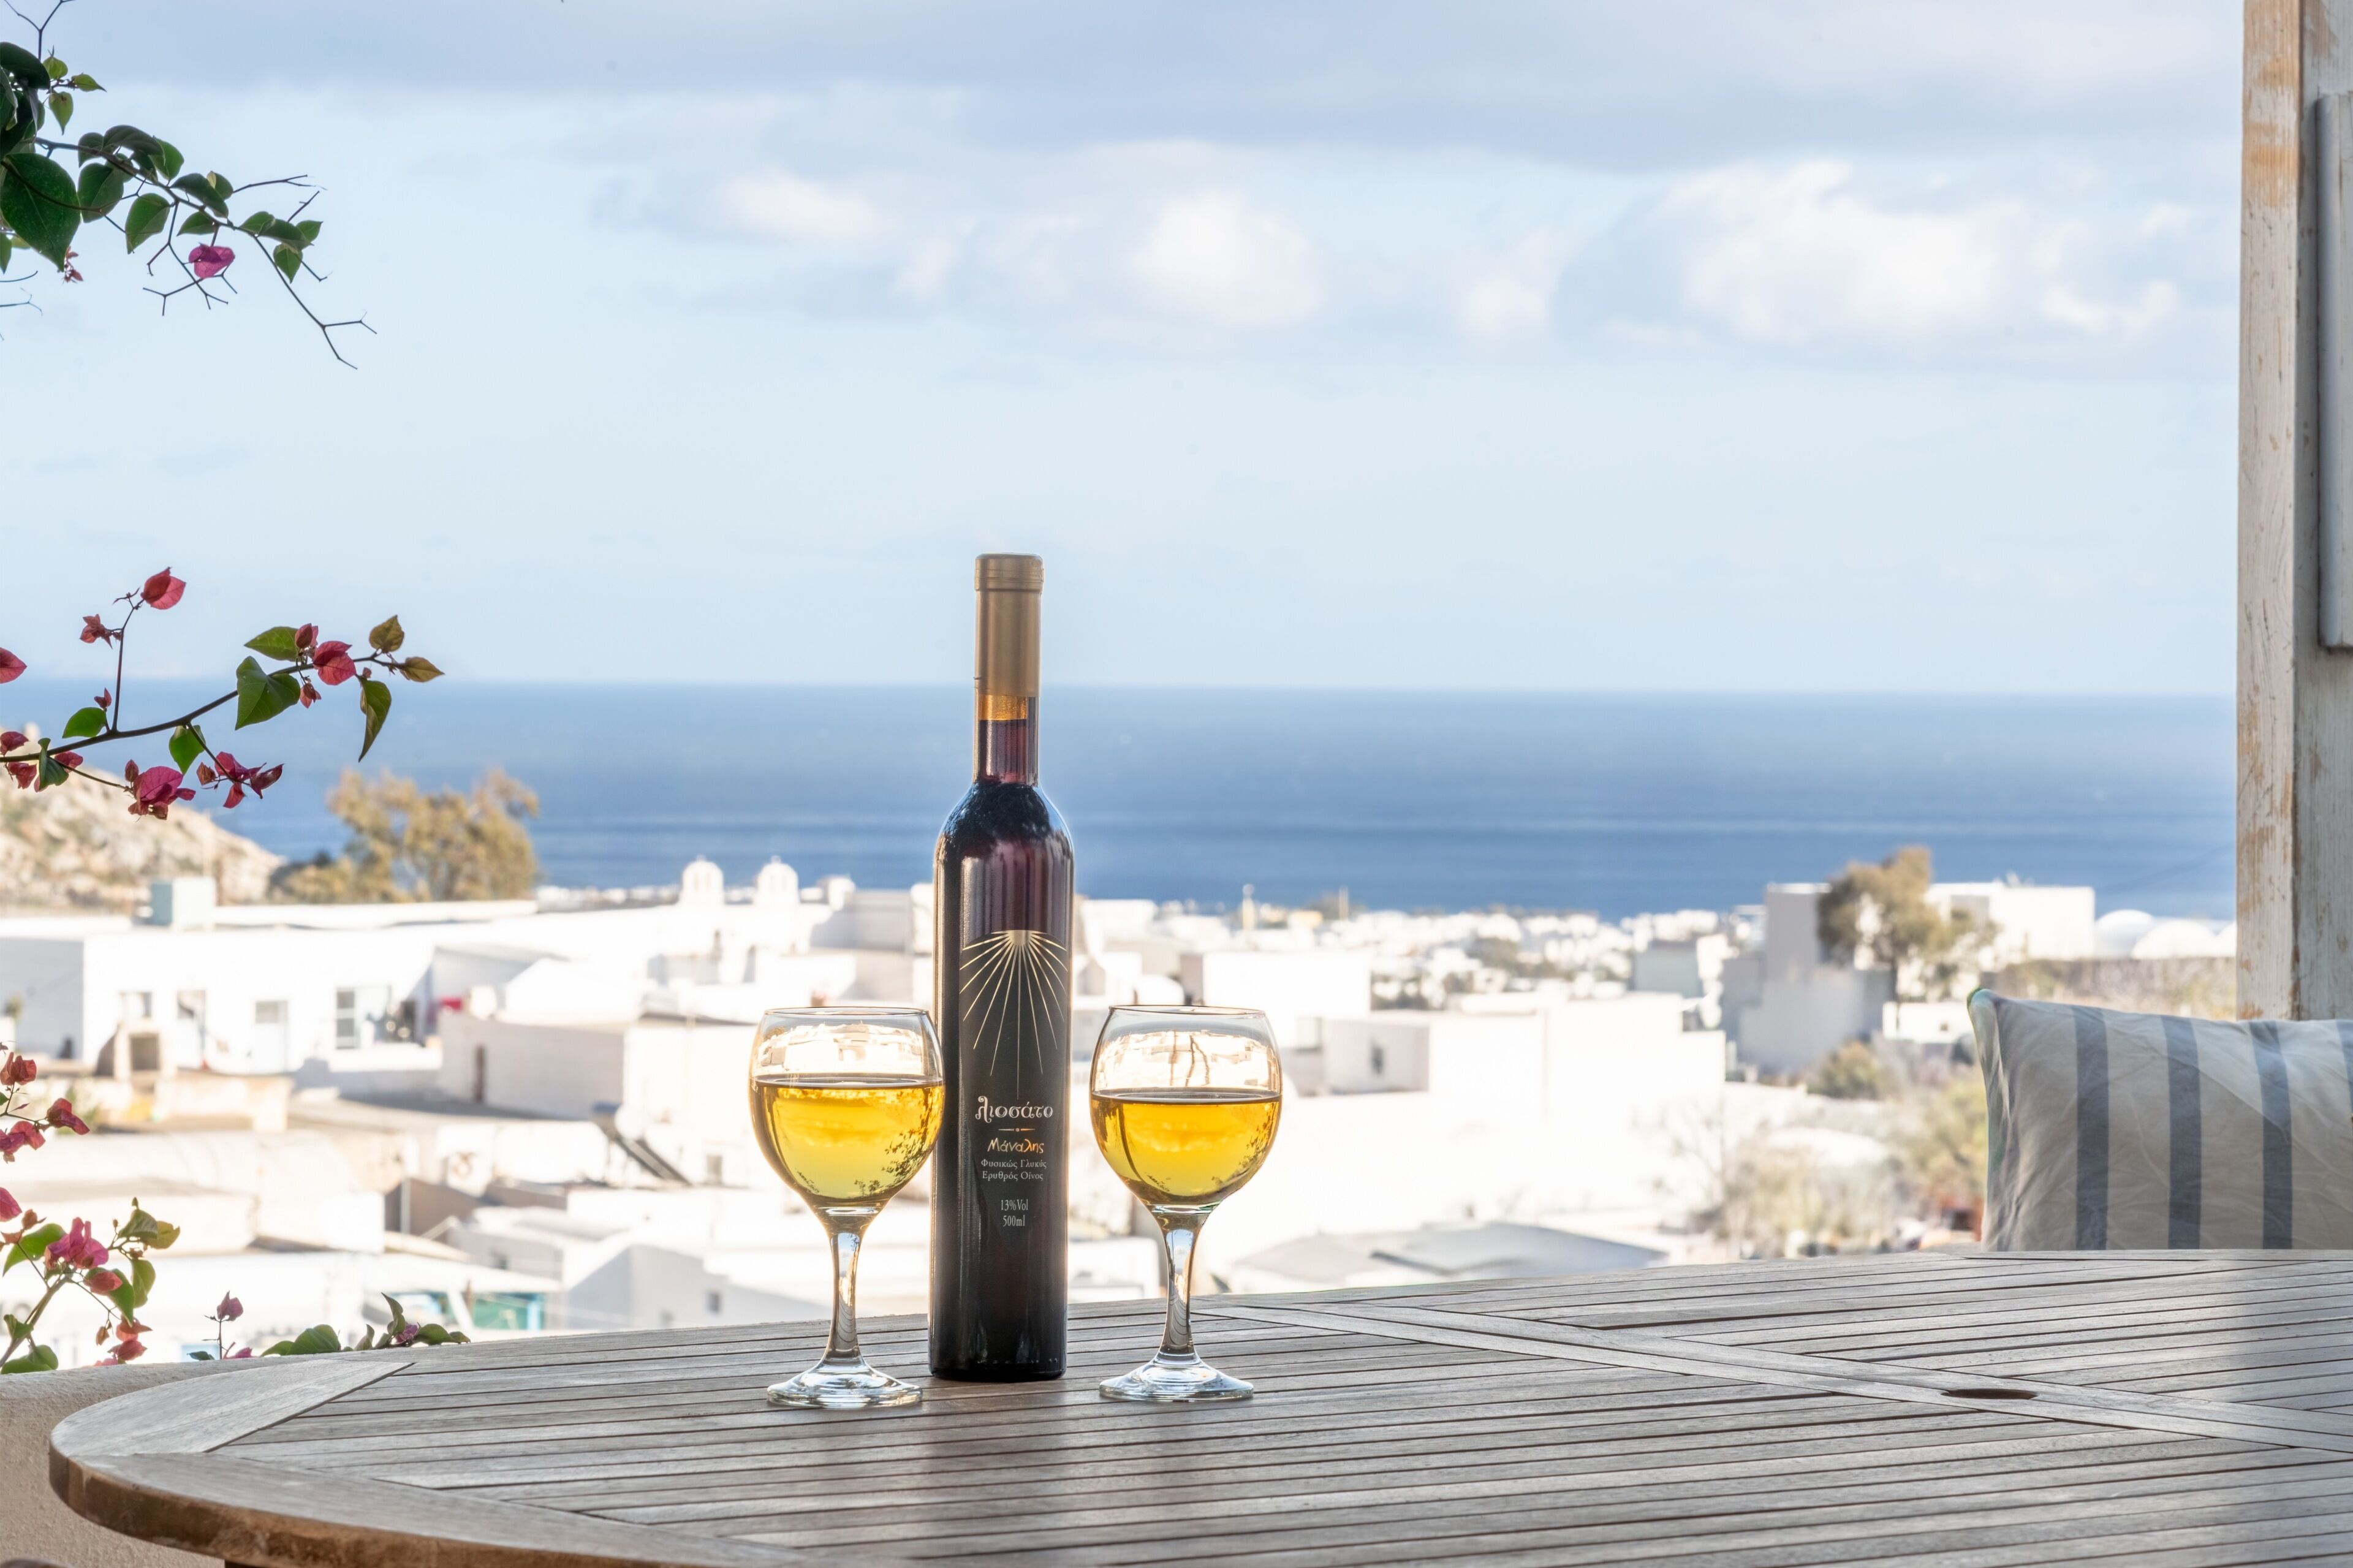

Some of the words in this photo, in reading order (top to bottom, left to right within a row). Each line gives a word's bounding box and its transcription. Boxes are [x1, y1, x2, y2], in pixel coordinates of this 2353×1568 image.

[987, 1137, 1044, 1154] Μάναλης
[981, 1159, 1018, 1170] Φυσικώς
[1020, 1159, 1047, 1170] Γλυκύς
[982, 1171, 1018, 1182] Ερυθρός
[1002, 1214, 1025, 1227] 500ml
